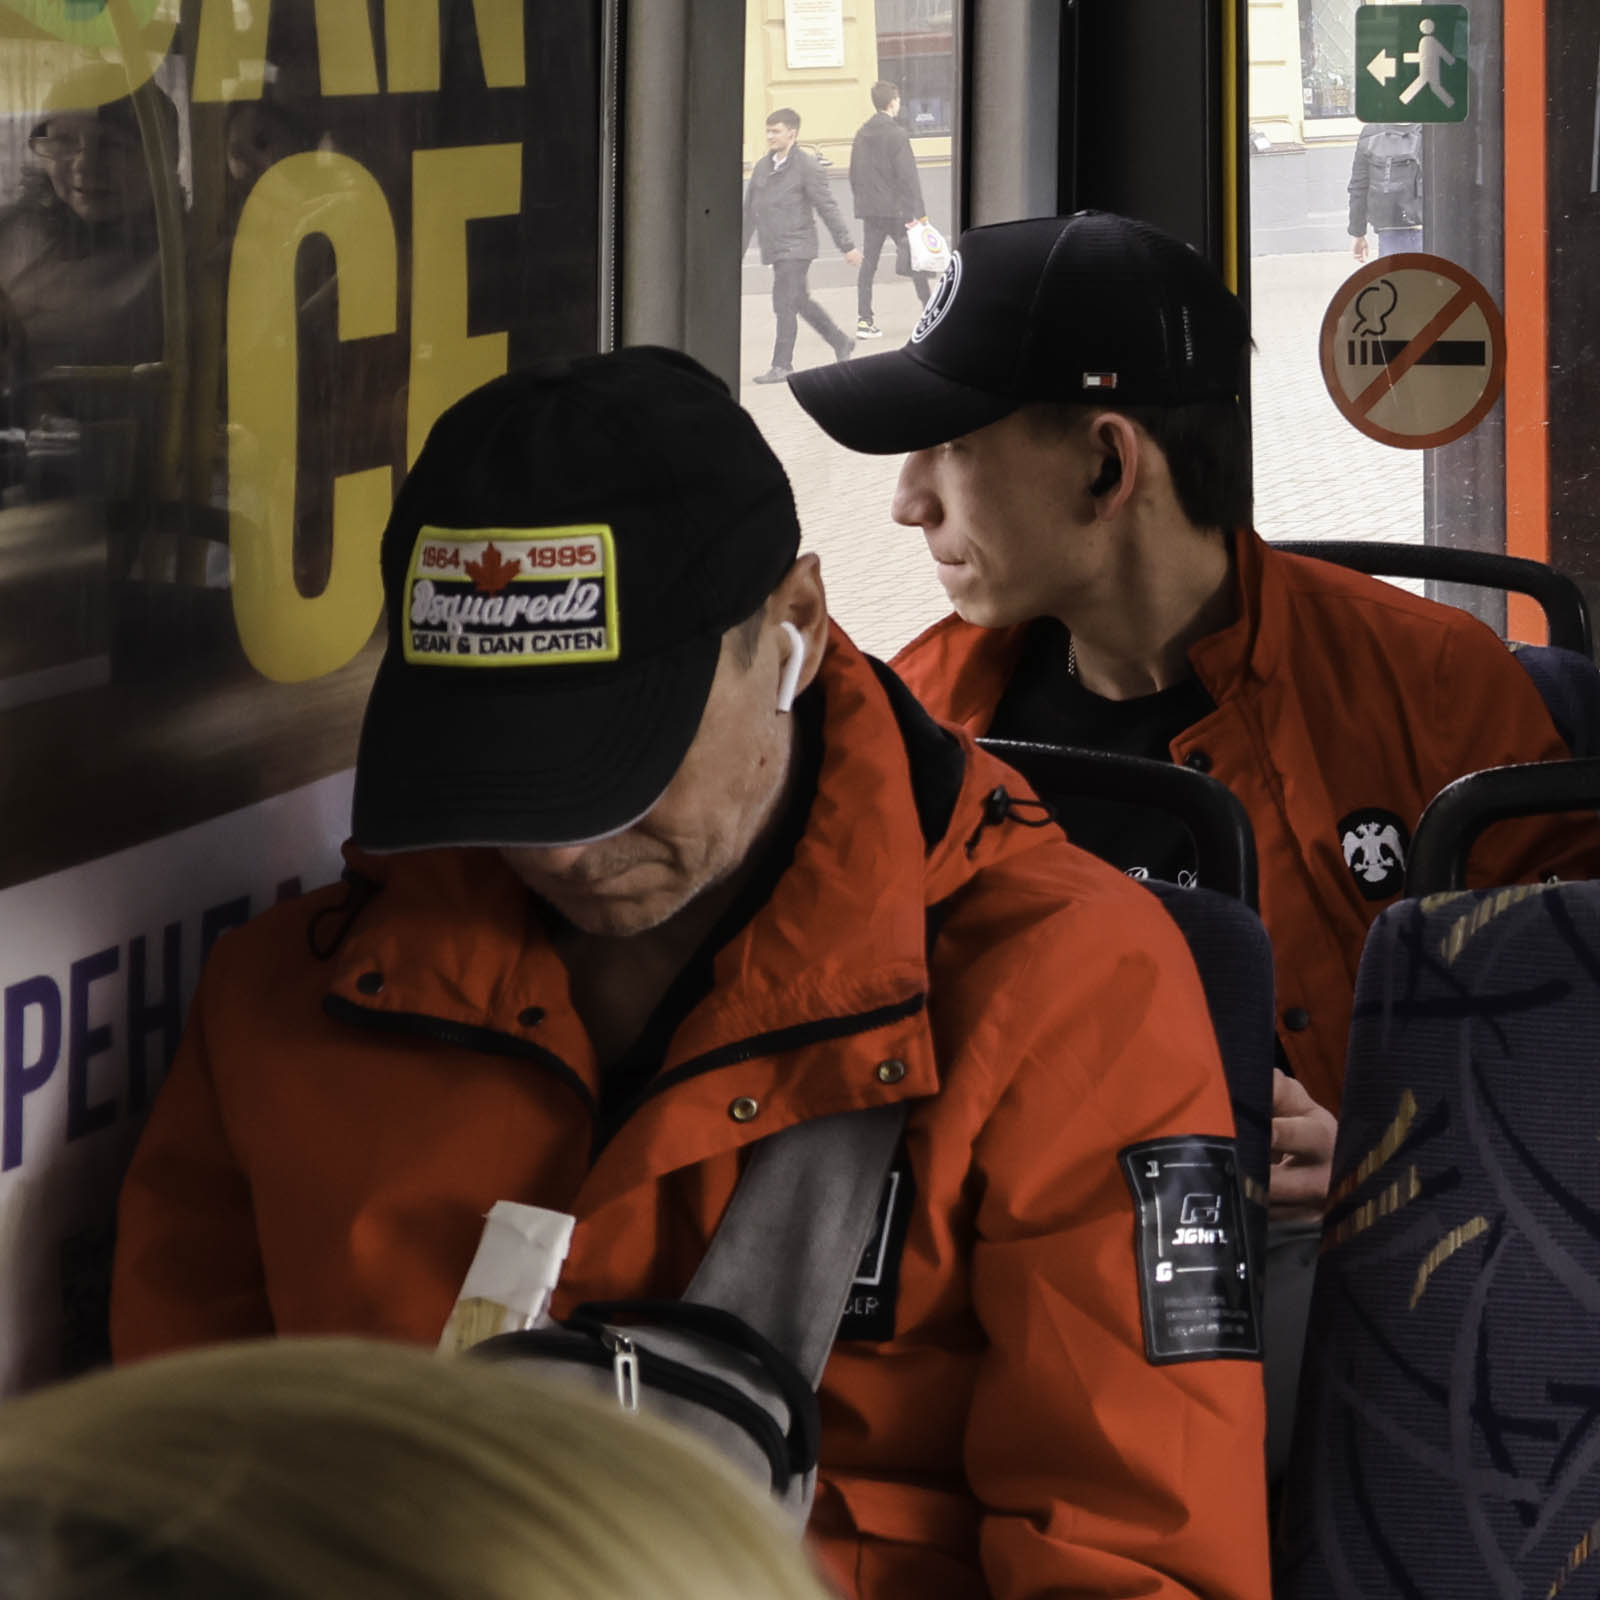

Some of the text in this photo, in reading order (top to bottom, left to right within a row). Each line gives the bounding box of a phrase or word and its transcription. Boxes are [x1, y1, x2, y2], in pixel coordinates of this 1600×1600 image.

[526, 544, 597, 568] 1995
[412, 632, 450, 653] DEAN
[479, 636, 524, 654] DAN
[531, 631, 602, 652] CATEN
